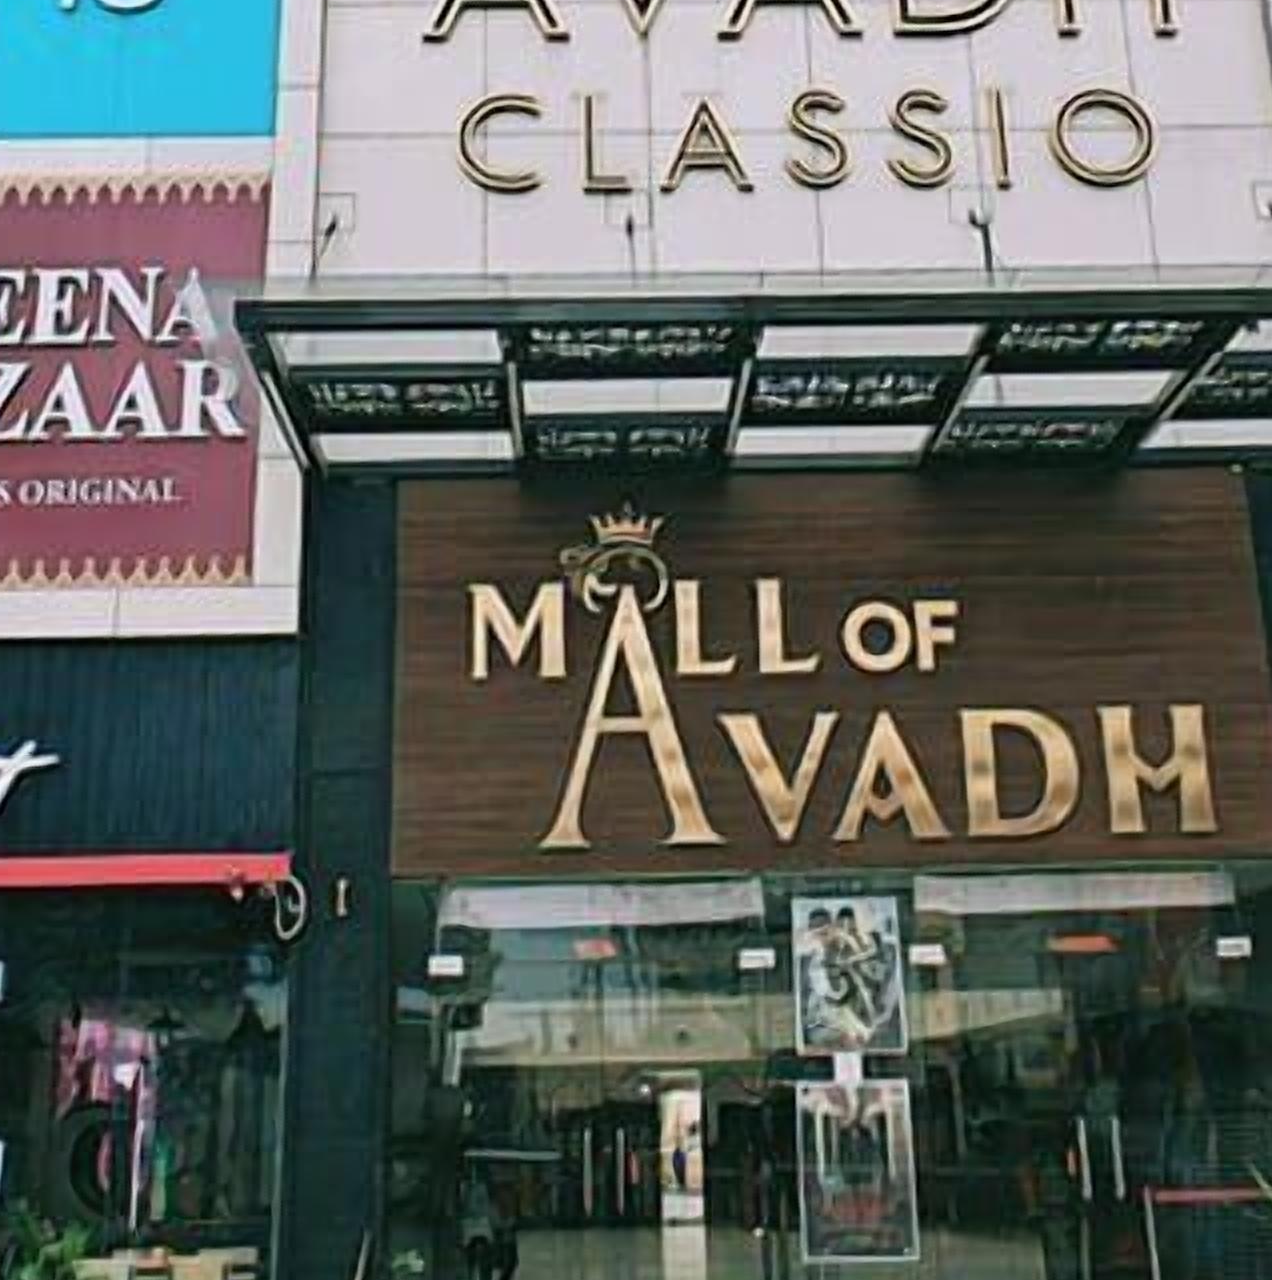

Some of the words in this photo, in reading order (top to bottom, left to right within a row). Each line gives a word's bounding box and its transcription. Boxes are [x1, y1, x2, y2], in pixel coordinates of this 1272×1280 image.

[18, 476, 184, 507] ORIGINAL
[841, 600, 960, 673] OF
[537, 582, 1218, 851] AVADH
